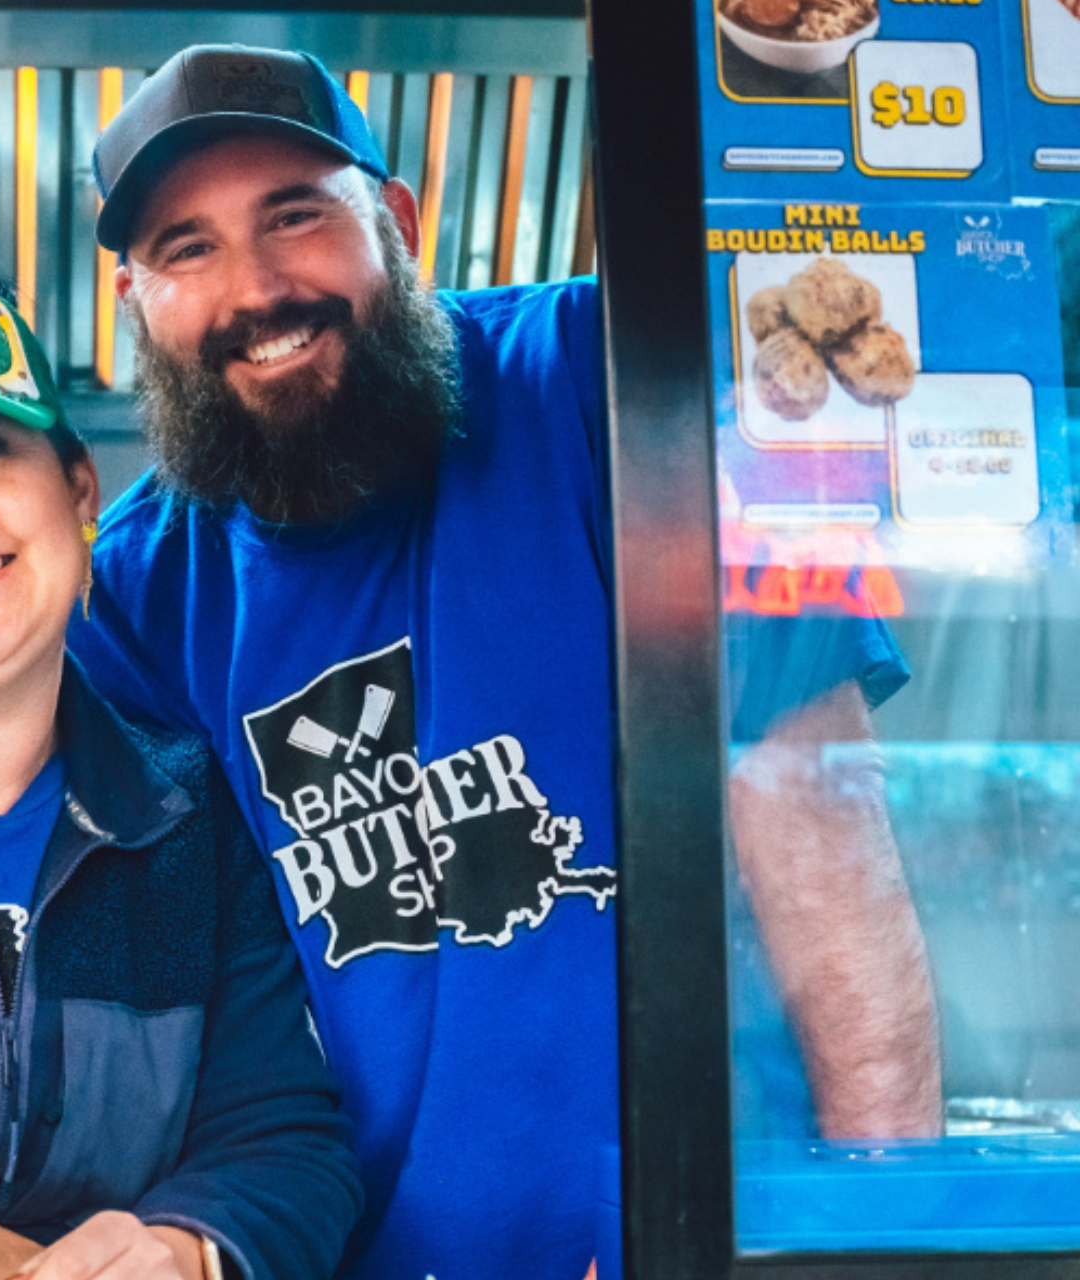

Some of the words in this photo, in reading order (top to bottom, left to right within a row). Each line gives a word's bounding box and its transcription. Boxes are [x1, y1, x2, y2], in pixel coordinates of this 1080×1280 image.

[870, 81, 967, 128] $10
[706, 229, 825, 253] BOUDIN
[832, 230, 926, 254] BALLS
[784, 204, 862, 227] MINI
[293, 752, 421, 831] BAYO
[272, 734, 548, 926] BUTER
[388, 834, 457, 918] SHP
